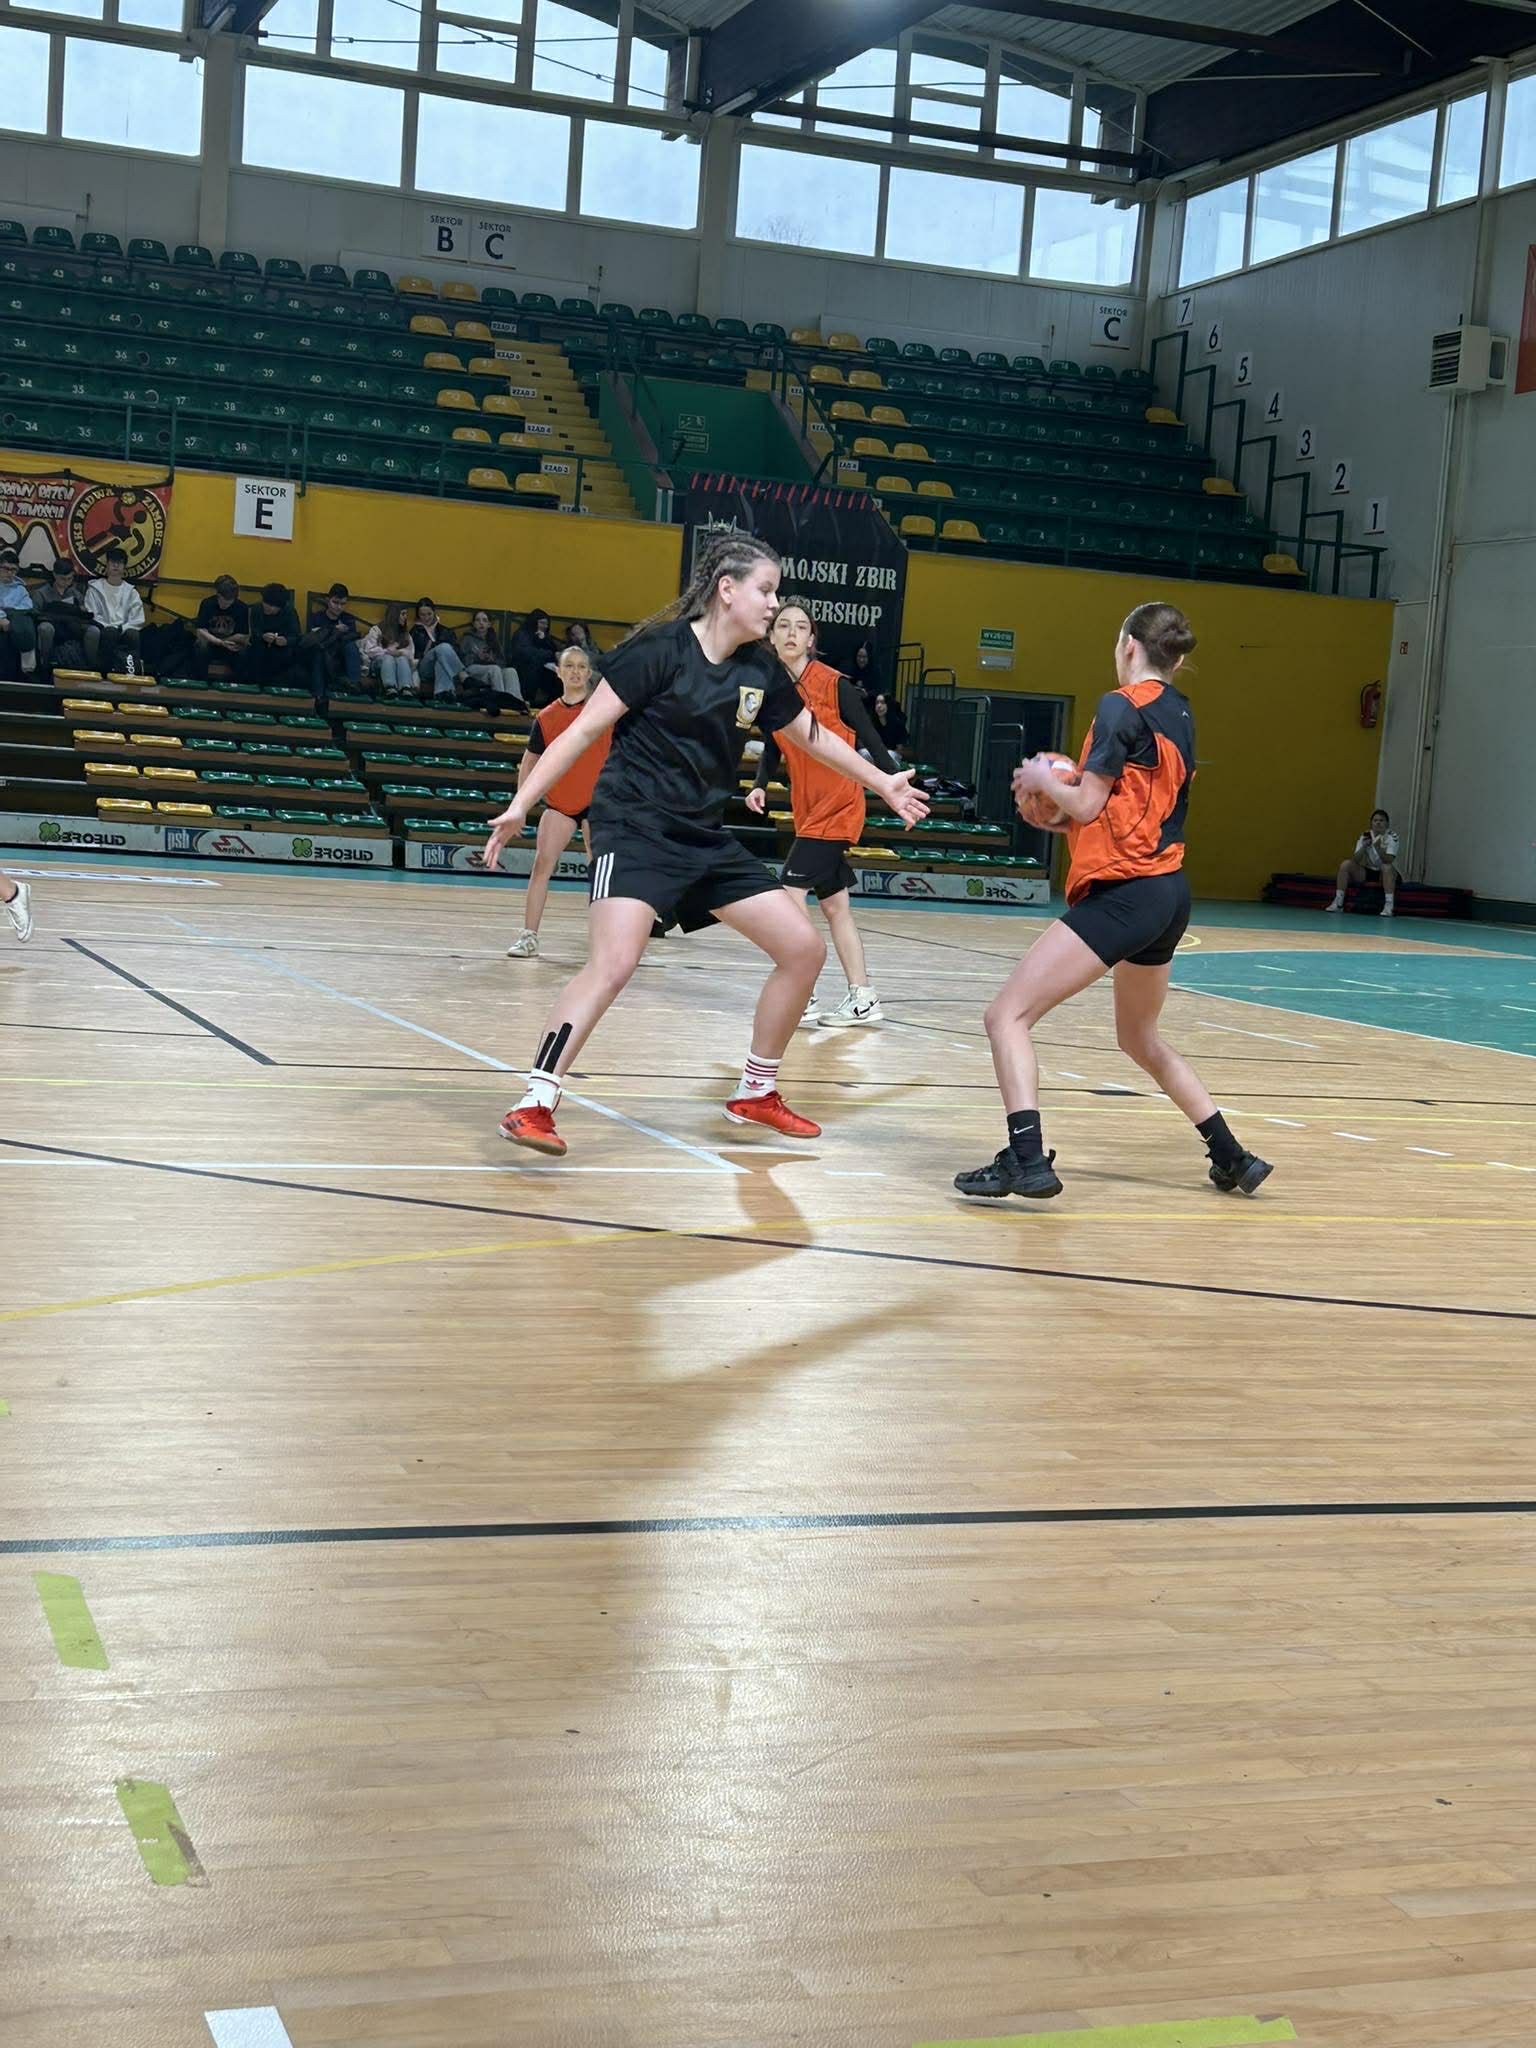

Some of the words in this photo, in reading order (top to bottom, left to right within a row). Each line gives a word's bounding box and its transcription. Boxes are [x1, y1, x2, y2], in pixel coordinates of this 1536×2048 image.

[430, 214, 463, 227] SEKTOR
[479, 221, 512, 233] SEKTOR
[48, 228, 58, 237] 51
[95, 234, 107, 244] 52
[436, 226, 454, 252] B
[142, 240, 154, 249] 53
[484, 233, 505, 260] C
[188, 247, 199, 256] 54
[233, 253, 245, 262] 55
[4, 262, 16, 272] 42
[323, 265, 334, 274] 57
[53, 269, 64, 278] 43
[101, 275, 113, 284] 44
[148, 281, 160, 291] 45
[196, 288, 208, 297] 46
[243, 294, 254, 302] 47
[10, 300, 22, 310] 42
[288, 299, 299, 309] 48
[60, 307, 72, 316] 43
[333, 306, 345, 315] 49
[1099, 305, 1128, 319] SEKTOR
[1181, 297, 1191, 322] 7
[108, 313, 121, 322] 44
[379, 311, 390, 321] 50
[157, 319, 170, 329] 45
[205, 326, 217, 335] 46
[1104, 317, 1121, 342] C
[253, 331, 265, 340] 47
[1209, 325, 1219, 349] 6
[14, 338, 27, 348] 34
[299, 337, 311, 346] 48
[65, 343, 78, 354] 35
[346, 343, 358, 352] 49
[115, 350, 128, 360] 36
[391, 349, 403, 358] 50
[165, 356, 177, 366] 37
[213, 362, 226, 372] 38
[1238, 357, 1249, 382] 5
[263, 368, 275, 378] 39
[19, 378, 33, 388] 34
[309, 374, 322, 384] 40
[72, 384, 85, 395] 35
[357, 380, 367, 389] 41
[122, 390, 136, 400] 36
[403, 386, 415, 395] 42
[223, 401, 236, 411] 38
[1268, 392, 1280, 417] 4
[274, 406, 286, 416] 39
[322, 412, 335, 422] 40
[24, 422, 38, 431] 34
[371, 418, 382, 428] 41
[78, 427, 91, 437] 35
[418, 425, 431, 434] 42
[184, 436, 197, 447] 37
[1300, 429, 1311, 455] 3
[235, 442, 248, 452] 38
[336, 453, 348, 462] 40
[384, 459, 395, 468] 41
[1335, 463, 1346, 490] 2
[244, 484, 287, 498] SEKTOR
[77, 488, 115, 519] PADWA
[255, 498, 274, 530] E
[1372, 502, 1379, 529] 1
[73, 523, 86, 553] MKS
[855, 565, 897, 591] ZBIR
[167, 831, 190, 851] psb
[423, 845, 445, 866] psb
